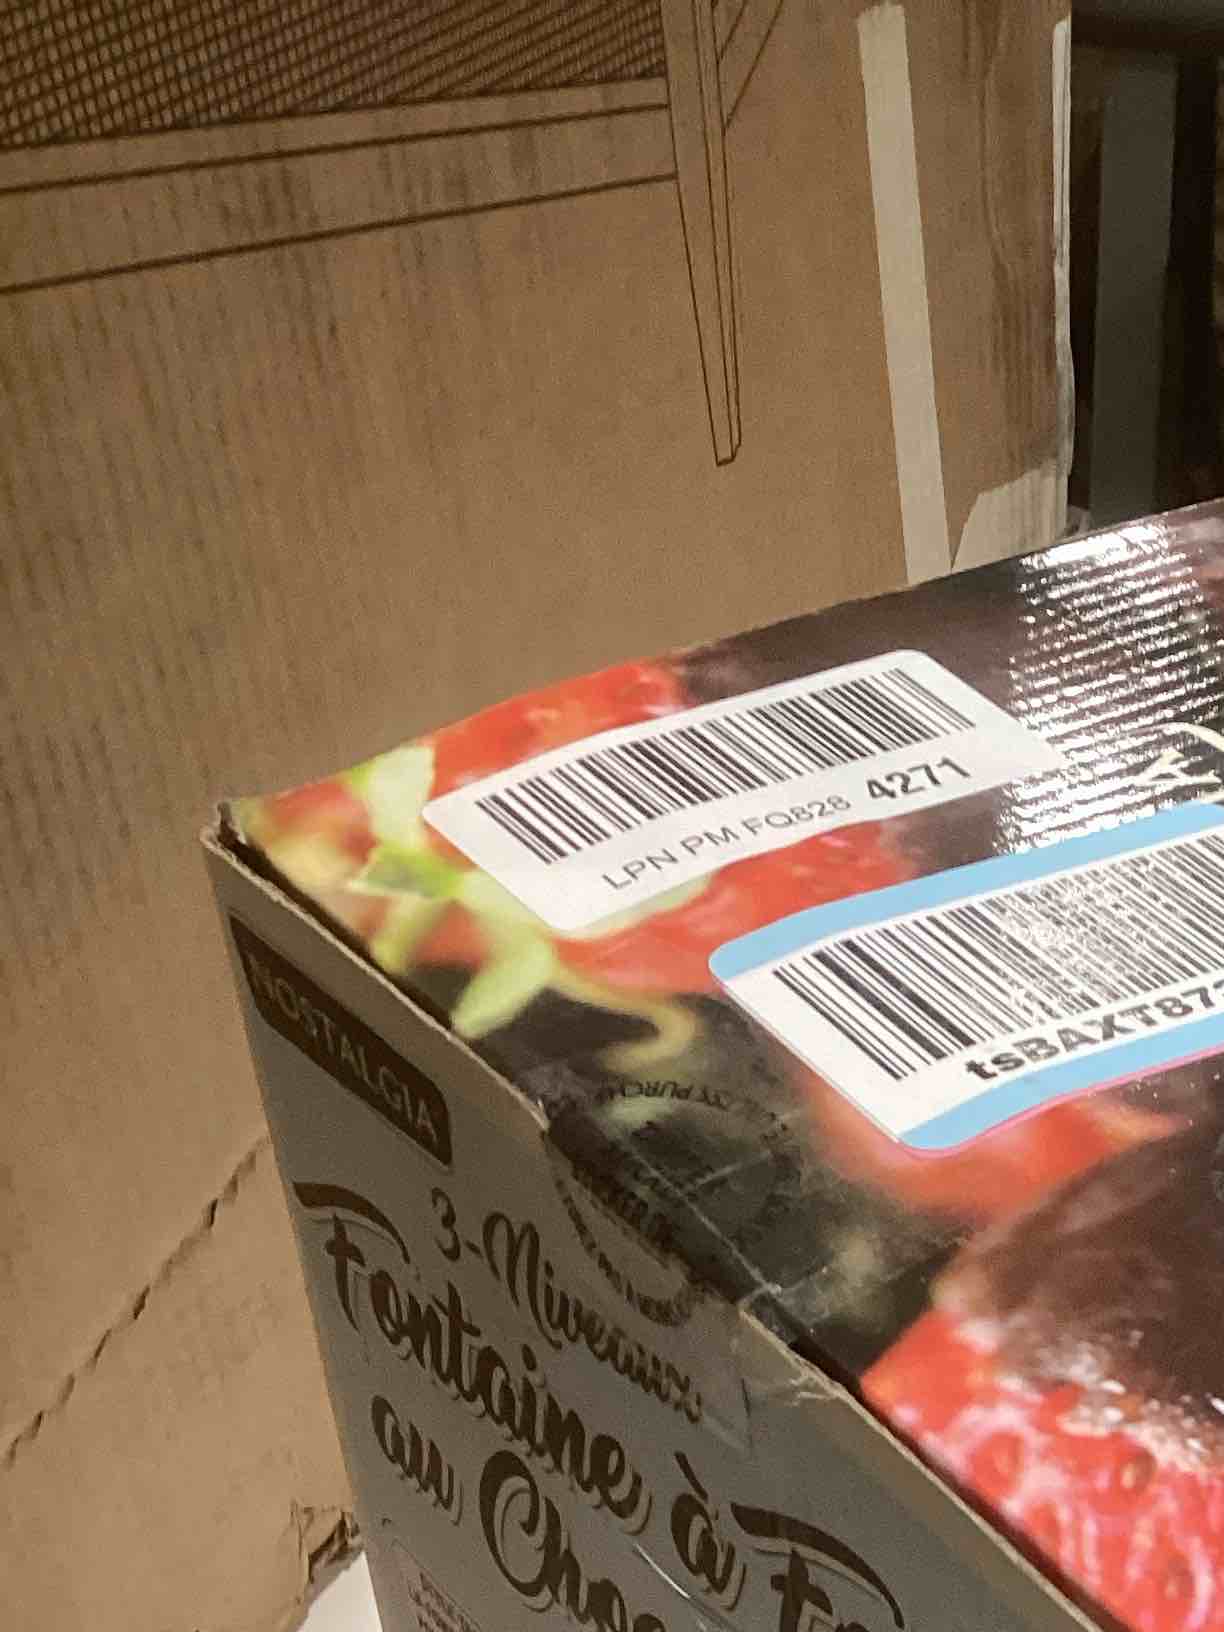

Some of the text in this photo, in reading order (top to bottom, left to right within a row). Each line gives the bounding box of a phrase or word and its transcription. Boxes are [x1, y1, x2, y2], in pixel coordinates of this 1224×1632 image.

[602, 757, 970, 890] LPN PM FQ828 4271
[293, 1181, 652, 1536] Fontaine
[673, 1451, 749, 1608] à
[432, 1187, 702, 1423] 3-Niveaux
[371, 1394, 462, 1524] au
